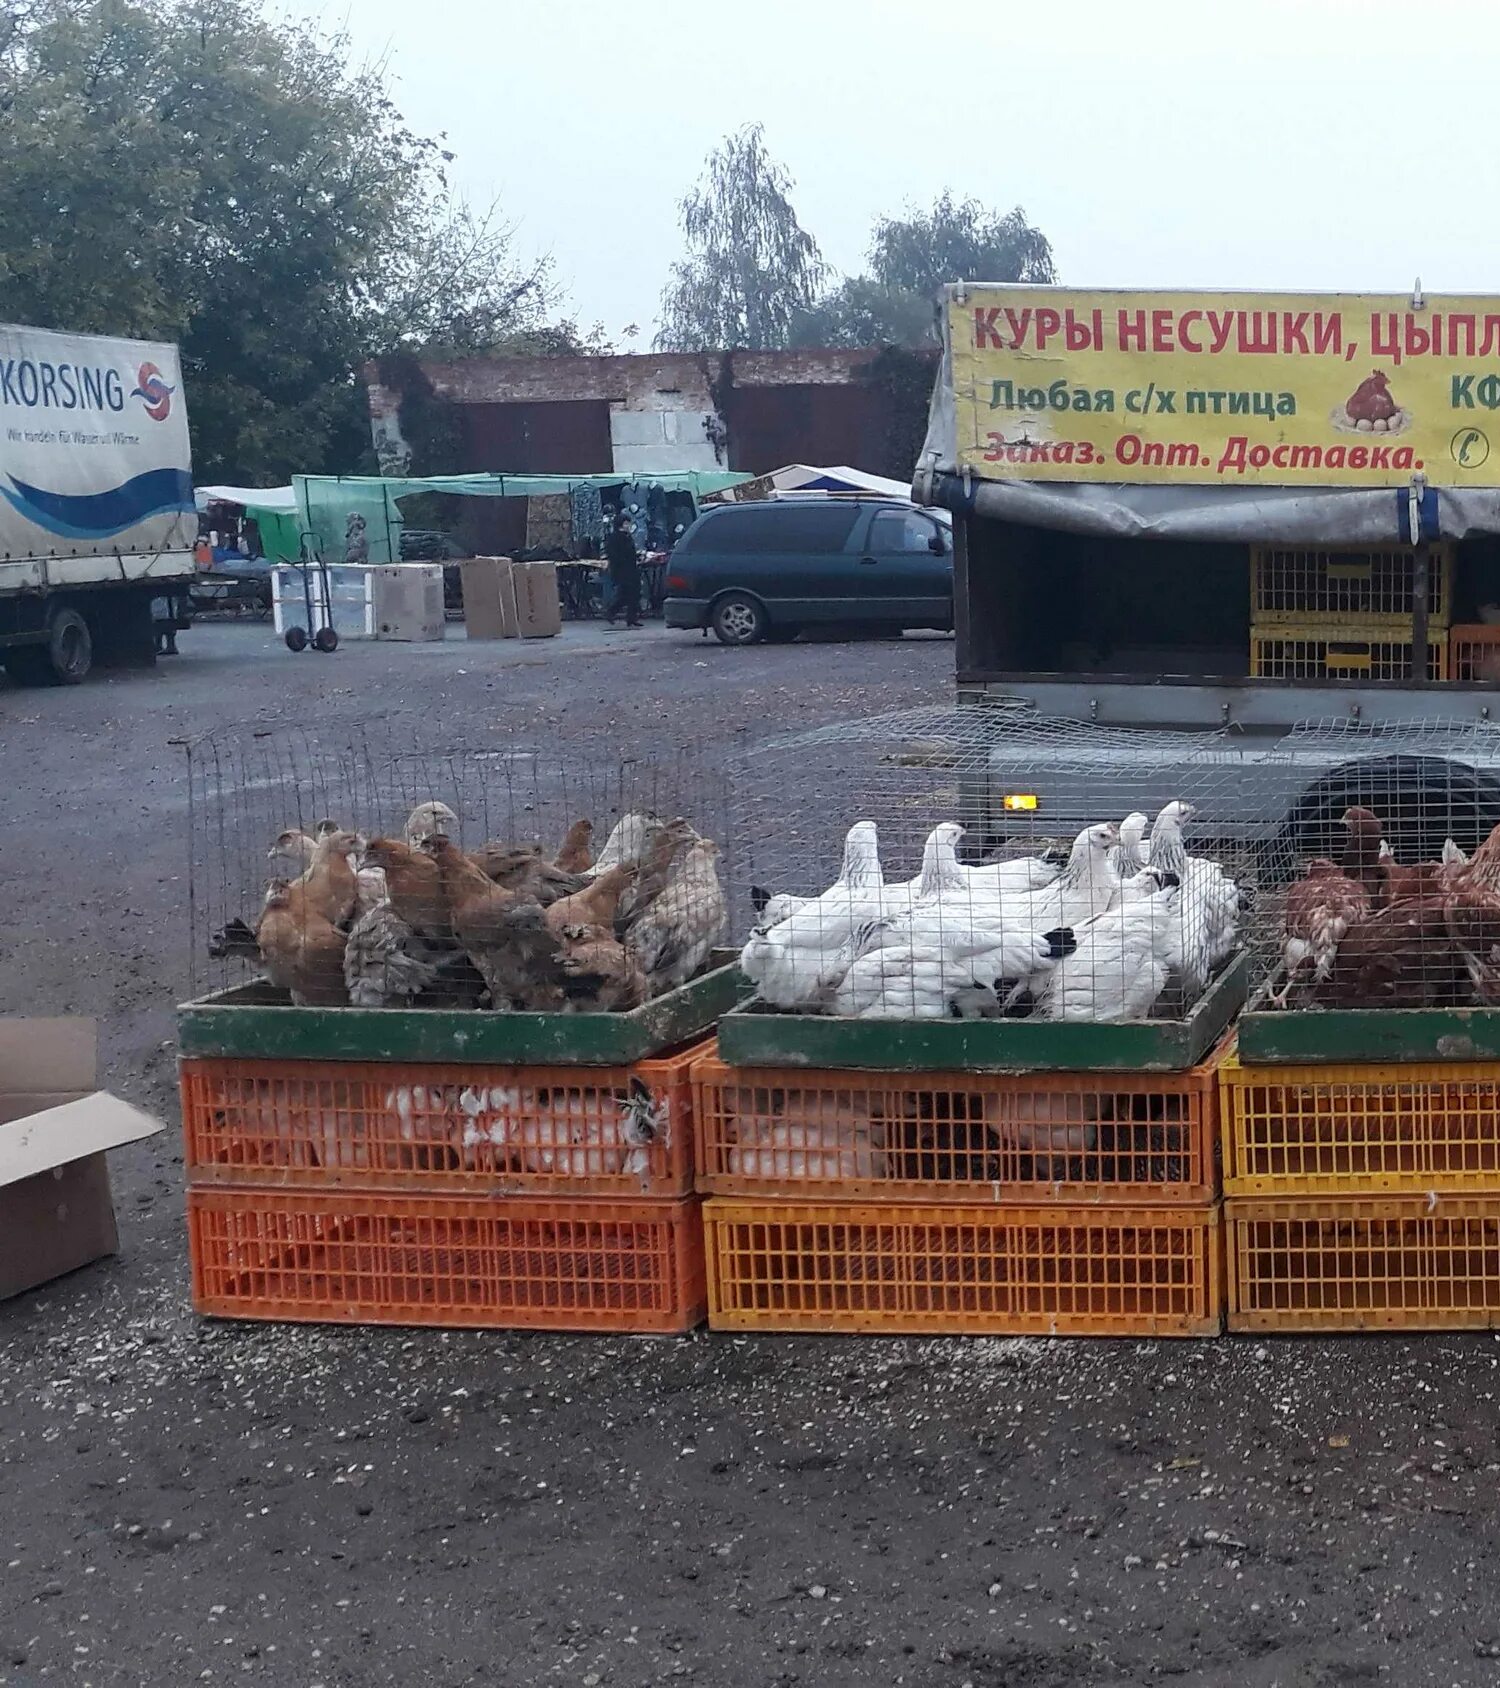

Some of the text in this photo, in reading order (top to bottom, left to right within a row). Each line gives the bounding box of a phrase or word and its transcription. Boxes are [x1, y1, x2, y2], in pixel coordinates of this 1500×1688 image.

[975, 307, 1104, 350] КУРЫ
[1118, 310, 1358, 361] НЕСУШКИ,
[0, 358, 124, 411] KORSING
[990, 379, 1296, 421] Любая с/х птица
[984, 432, 1424, 474] Заказ. Опт. Доставка.
